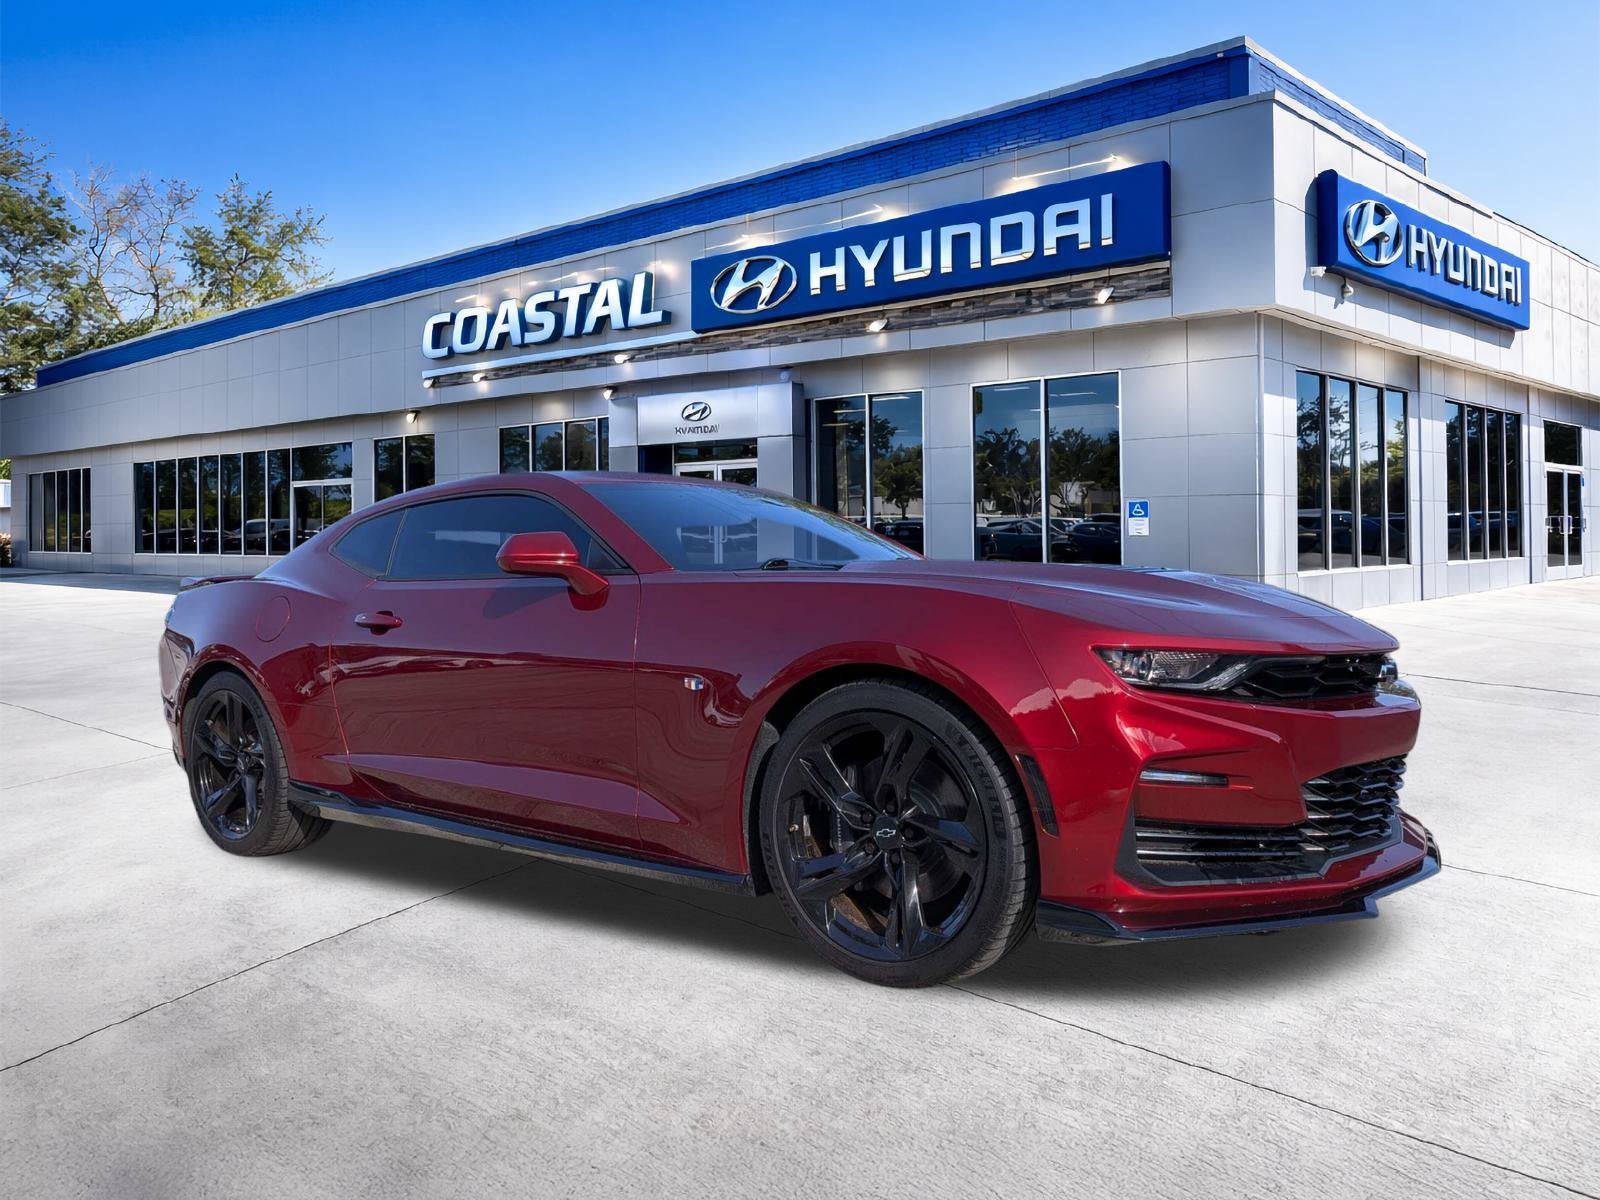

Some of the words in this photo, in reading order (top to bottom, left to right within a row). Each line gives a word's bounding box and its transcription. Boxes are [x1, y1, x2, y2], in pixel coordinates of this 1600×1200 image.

[809, 192, 1114, 296] HYUNDAI
[1406, 224, 1522, 306] HYUNDAI
[422, 271, 667, 360] COASTAL
